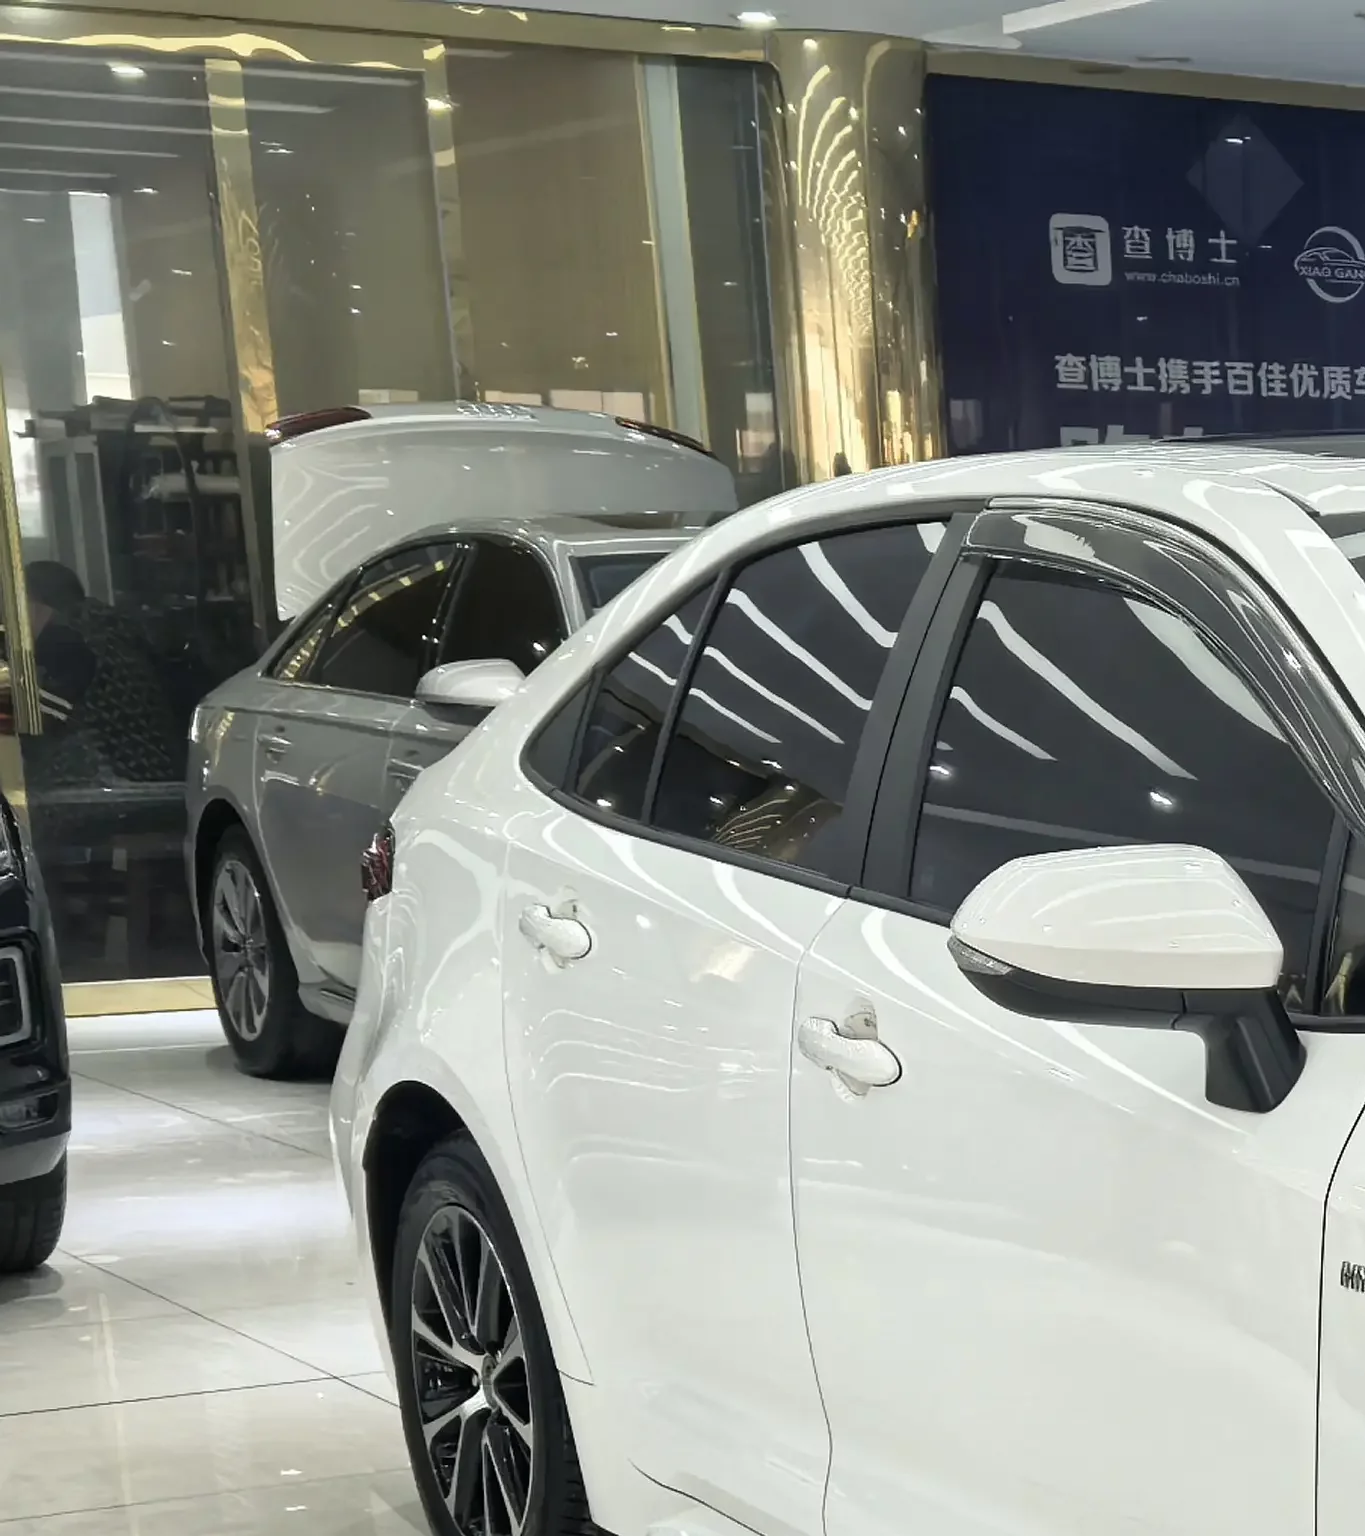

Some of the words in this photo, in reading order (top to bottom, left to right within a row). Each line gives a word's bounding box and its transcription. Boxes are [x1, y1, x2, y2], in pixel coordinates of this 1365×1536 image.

[1121, 225, 1238, 264] 查博士
[1123, 270, 1241, 288] www.chaboshi.cn
[1299, 265, 1333, 278] XIAO
